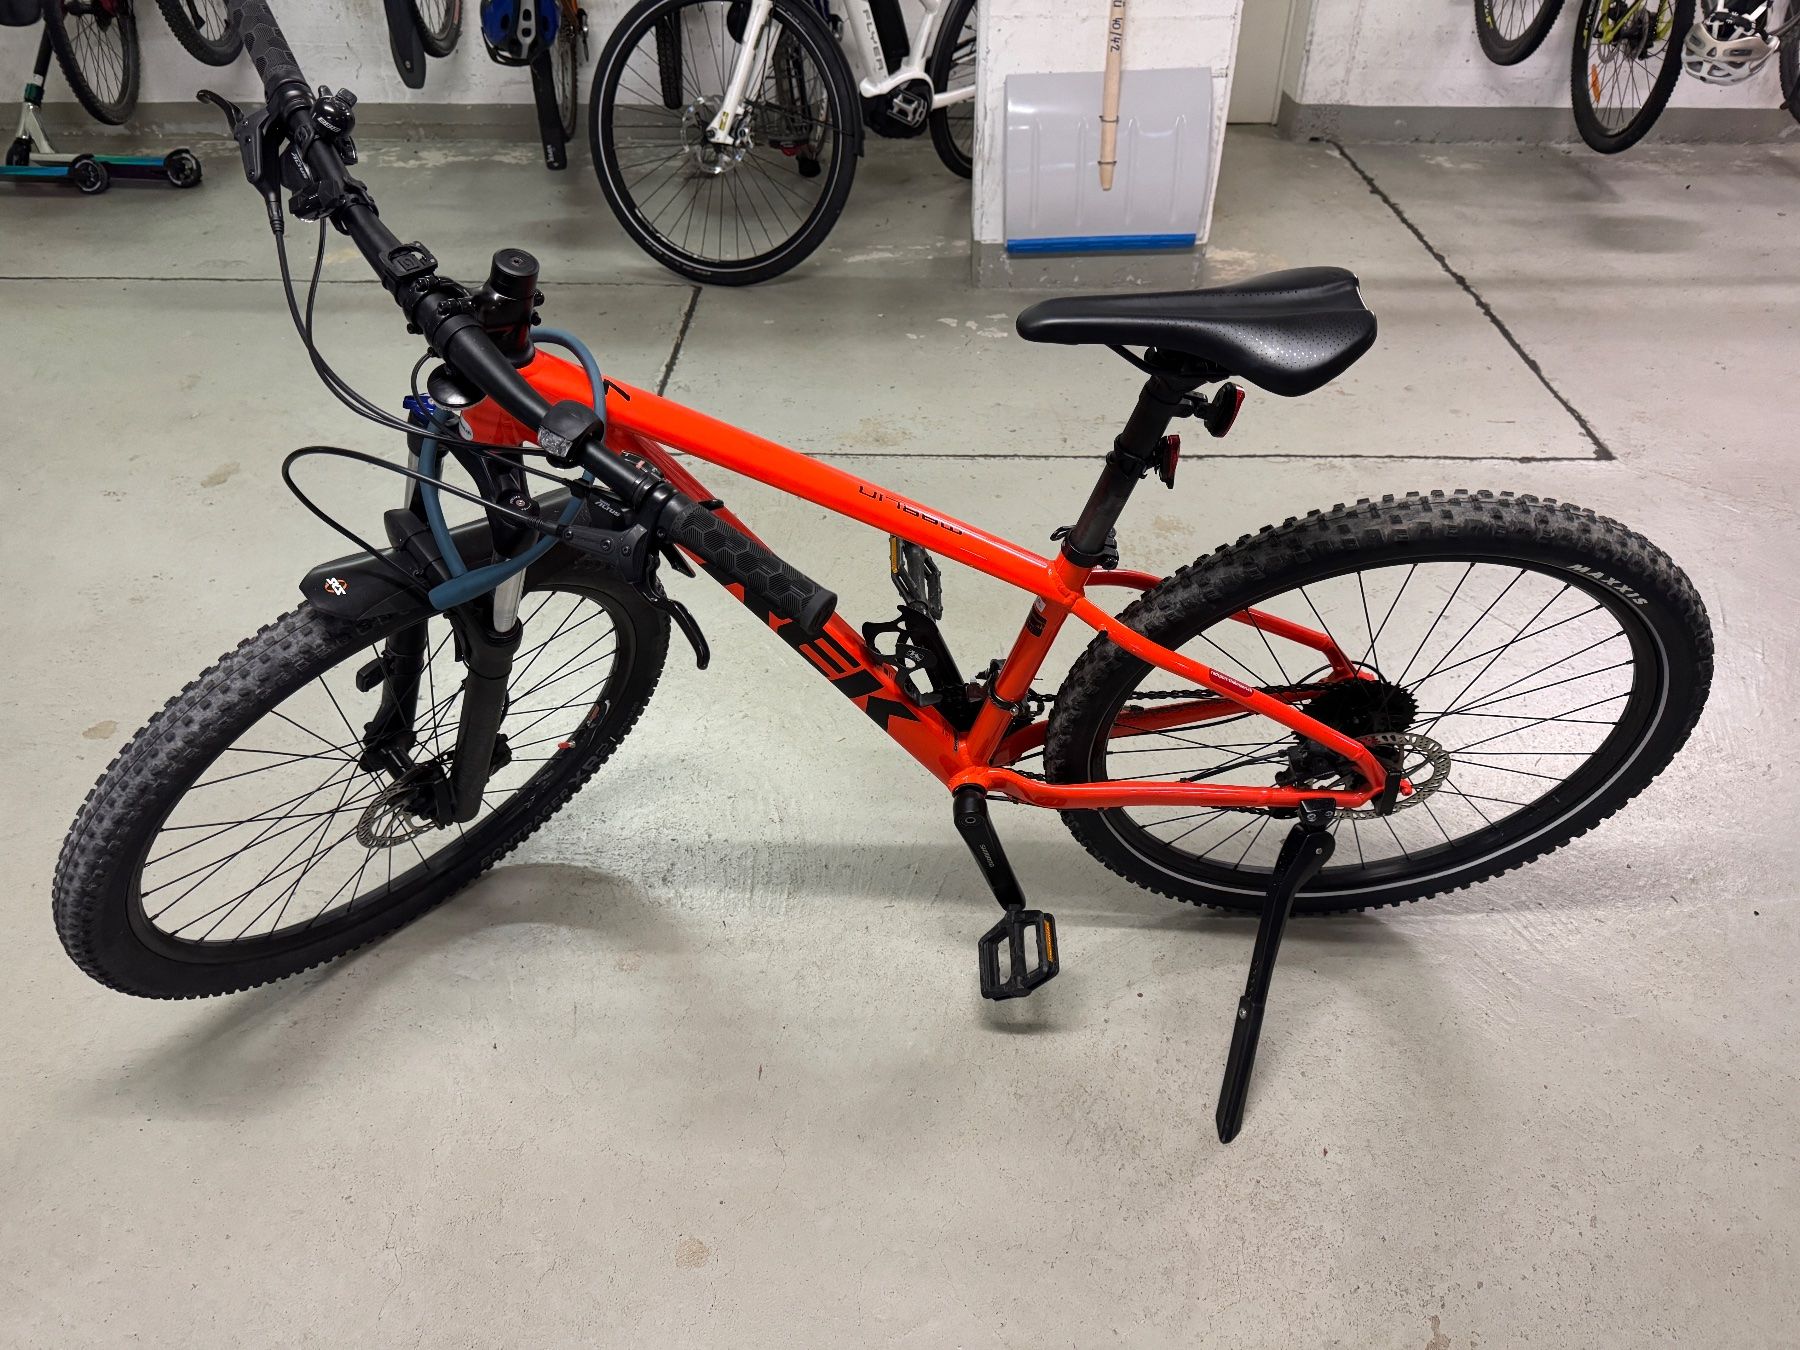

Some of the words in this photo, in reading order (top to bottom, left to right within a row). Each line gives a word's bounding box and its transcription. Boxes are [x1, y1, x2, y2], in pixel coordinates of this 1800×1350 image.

[863, 9, 884, 70] FLYER
[1110, 17, 1123, 52] 40/42
[1566, 564, 1649, 605] MAXXIS
[480, 788, 570, 868] BONTRAGER
